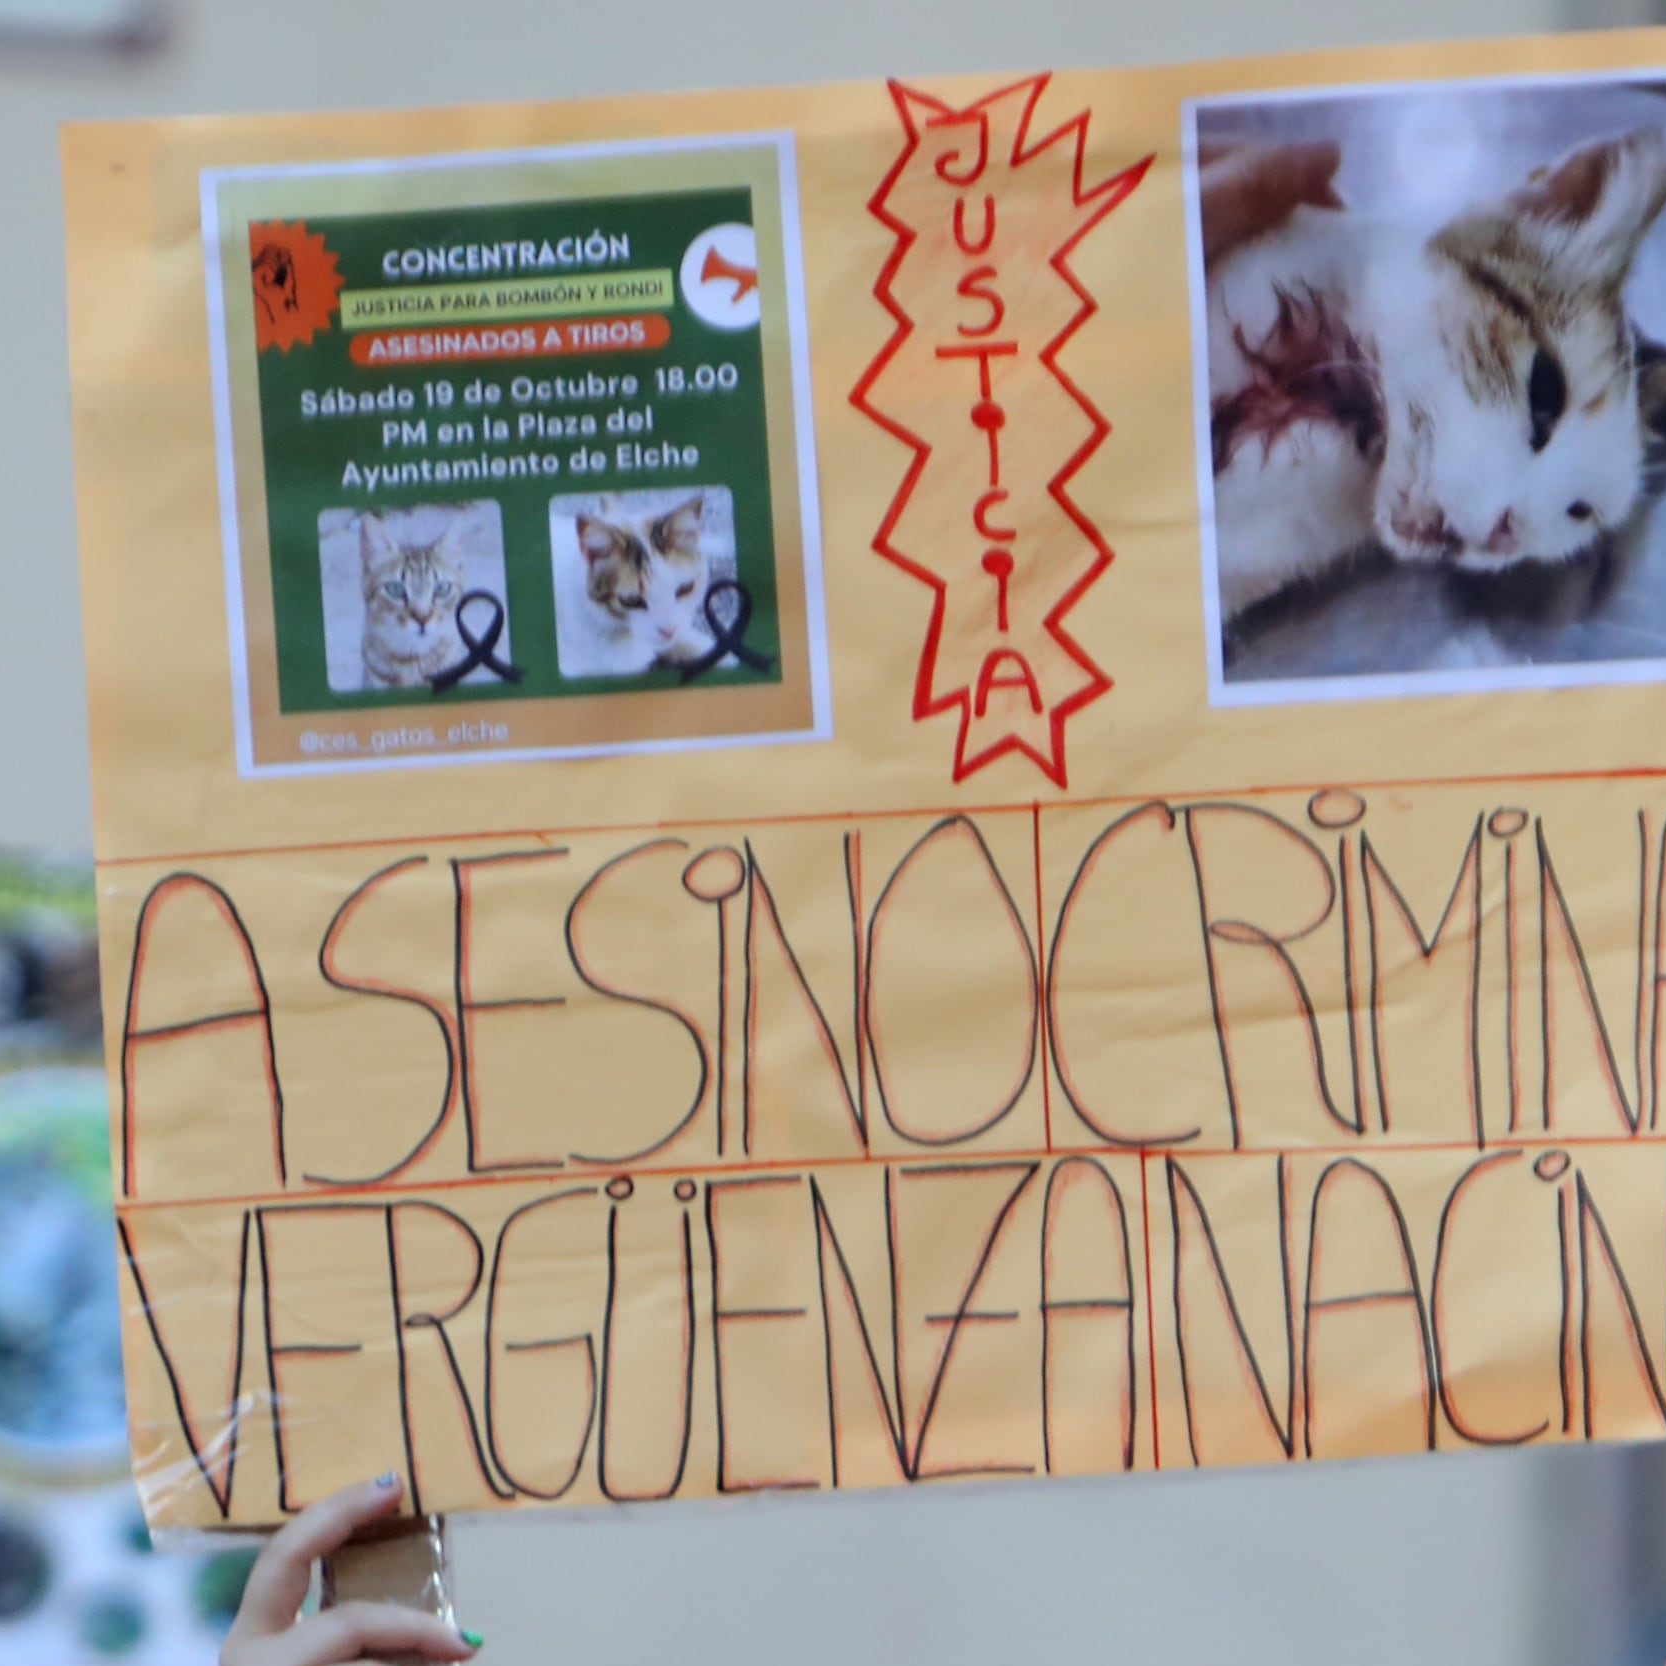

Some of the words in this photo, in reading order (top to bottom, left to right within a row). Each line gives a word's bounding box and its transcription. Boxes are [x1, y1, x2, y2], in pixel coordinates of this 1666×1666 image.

[382, 229, 631, 277] CONCENTRACIÓN
[349, 294, 437, 318] JUSTICIA
[439, 292, 492, 313] PARA
[495, 280, 582, 309] BOMBÓN
[585, 284, 600, 303] Y
[368, 329, 536, 361] ASESINADOS
[541, 326, 563, 350] A
[565, 319, 647, 346] TIROS
[299, 382, 416, 417] Sábado
[423, 380, 456, 408] 19
[462, 375, 503, 403] de
[509, 370, 640, 403] Octubre
[653, 362, 740, 394] 18.00
[382, 421, 429, 447] PM
[436, 423, 476, 445] en
[481, 414, 510, 441] la
[517, 410, 597, 438] Plaza
[605, 403, 654, 432] del
[341, 449, 561, 492] Ayuntamiento
[569, 446, 607, 472] de
[615, 441, 701, 470] Elche
[298, 717, 511, 755] @ces_gatos_elche
[115, 1155, 1135, 1521] VERGÜENZA
